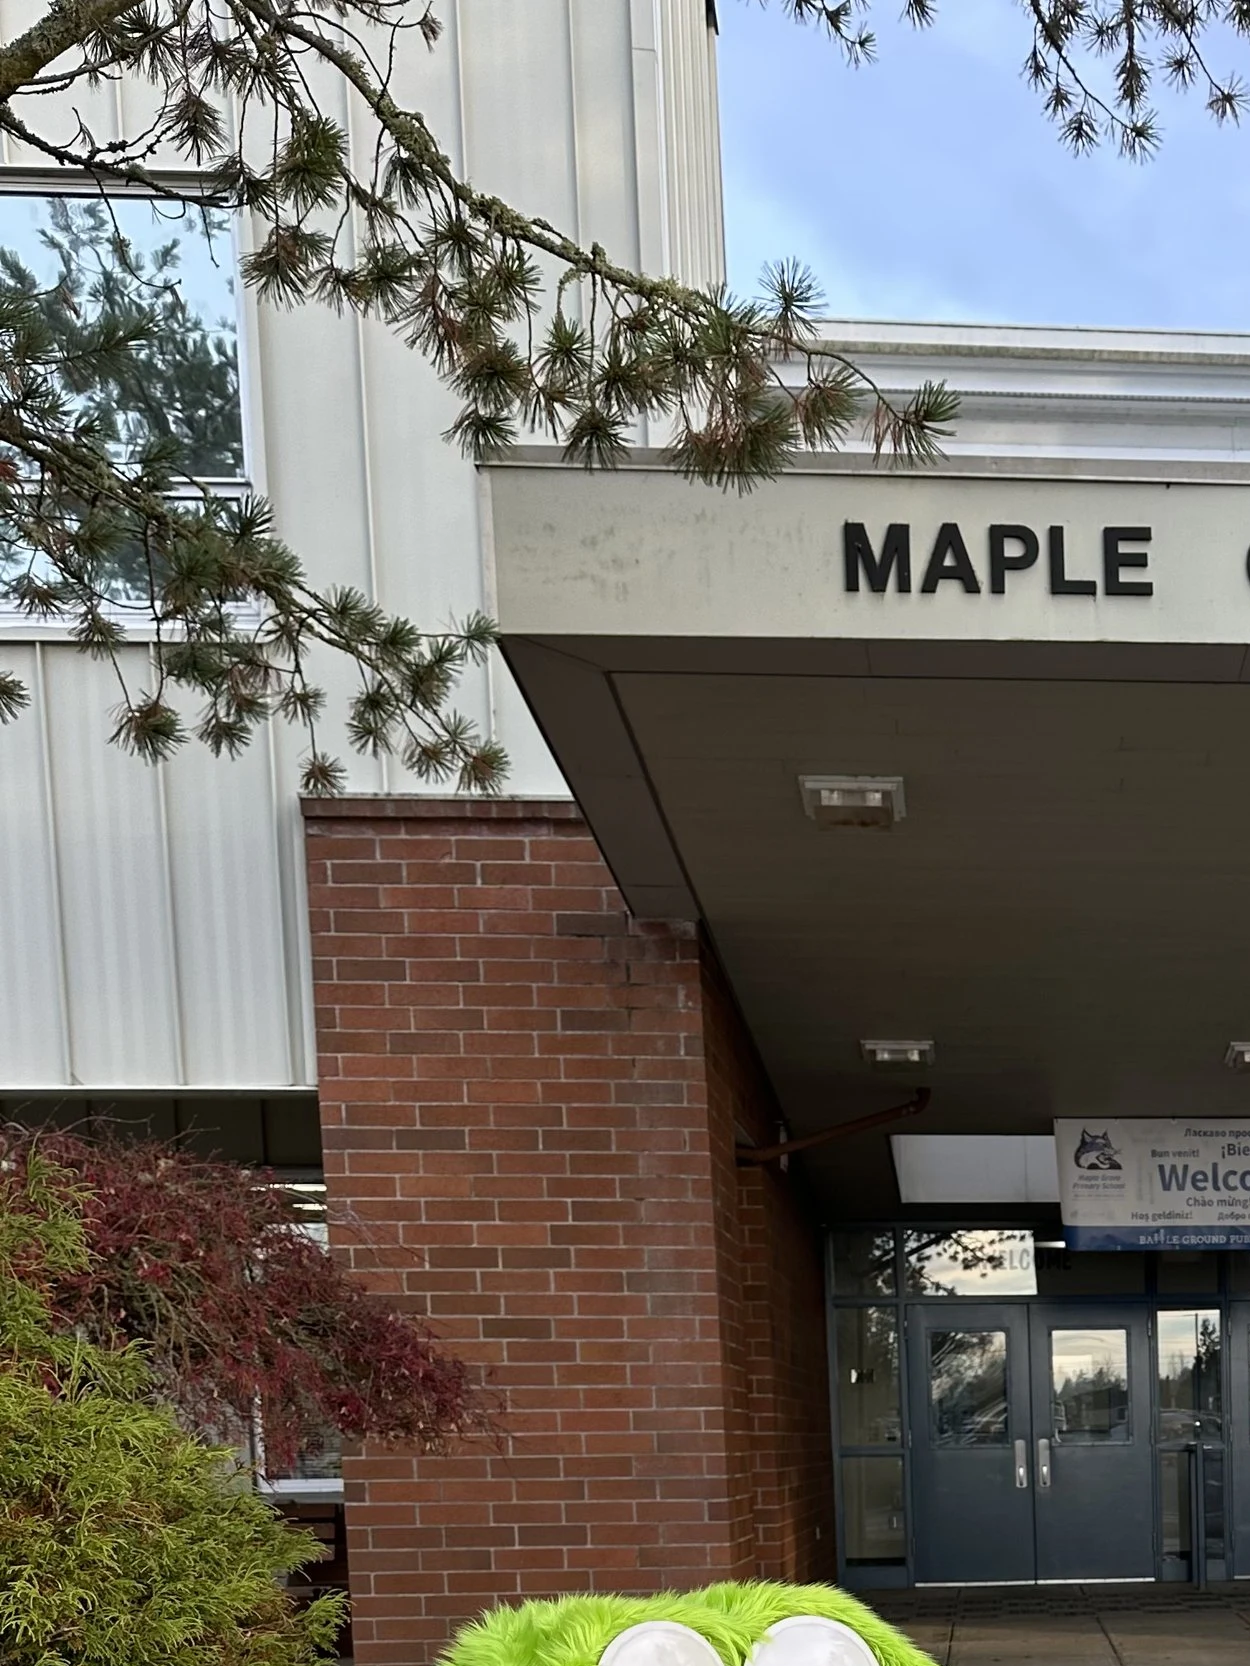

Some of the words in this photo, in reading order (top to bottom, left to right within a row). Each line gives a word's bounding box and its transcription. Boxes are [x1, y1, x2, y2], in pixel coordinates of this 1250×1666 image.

[843, 520, 1154, 598] MAPLE
[1184, 1128, 1227, 1138] Ласкаво
[1151, 1149, 1170, 1158] Bun
[1172, 1148, 1200, 1158] venit!
[1102, 1182, 1126, 1190] School
[1186, 1196, 1214, 1207] Chào
[1131, 1211, 1149, 1222] Hoş
[1151, 1211, 1193, 1222] geldiniz!
[1217, 1211, 1246, 1221] Добро
[1182, 1235, 1227, 1244] GROUND
